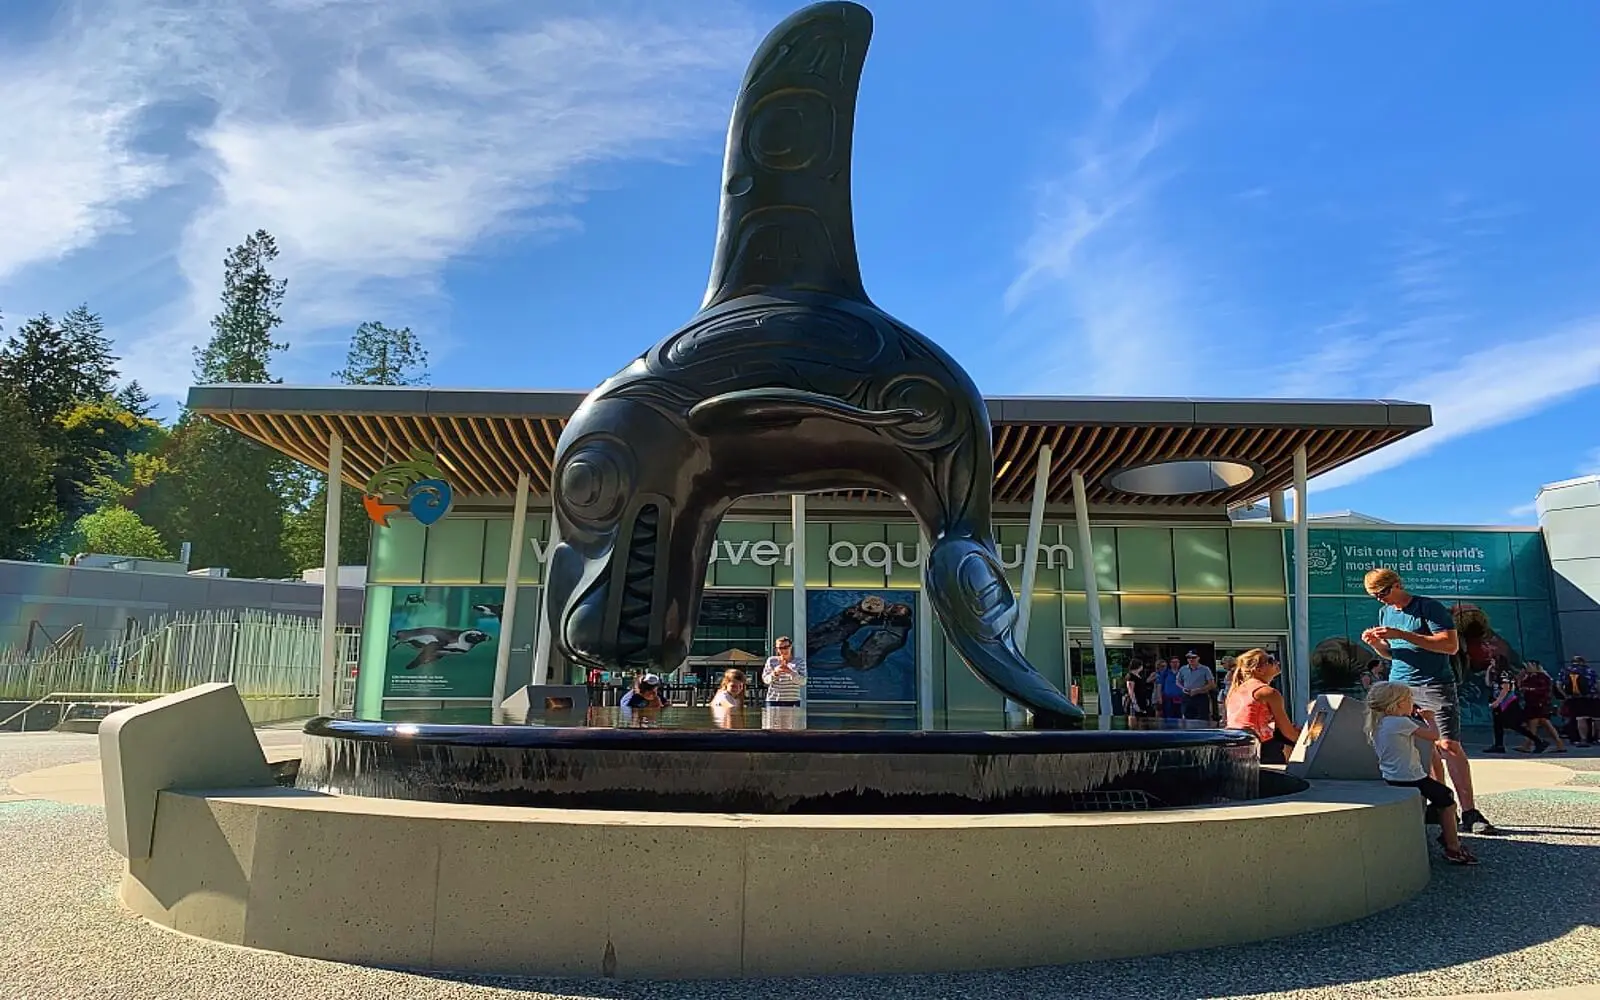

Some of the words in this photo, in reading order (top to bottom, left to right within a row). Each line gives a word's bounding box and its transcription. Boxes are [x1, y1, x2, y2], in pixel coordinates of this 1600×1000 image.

[828, 541, 1074, 575] aquum
[1343, 545, 1373, 557] Visit
[1375, 548, 1398, 557] one
[1402, 547, 1415, 558] of
[1418, 547, 1438, 558] the
[1441, 547, 1484, 559] world's
[1345, 559, 1376, 570] most
[1380, 559, 1413, 571] loved
[1417, 561, 1486, 574] aquariums.
